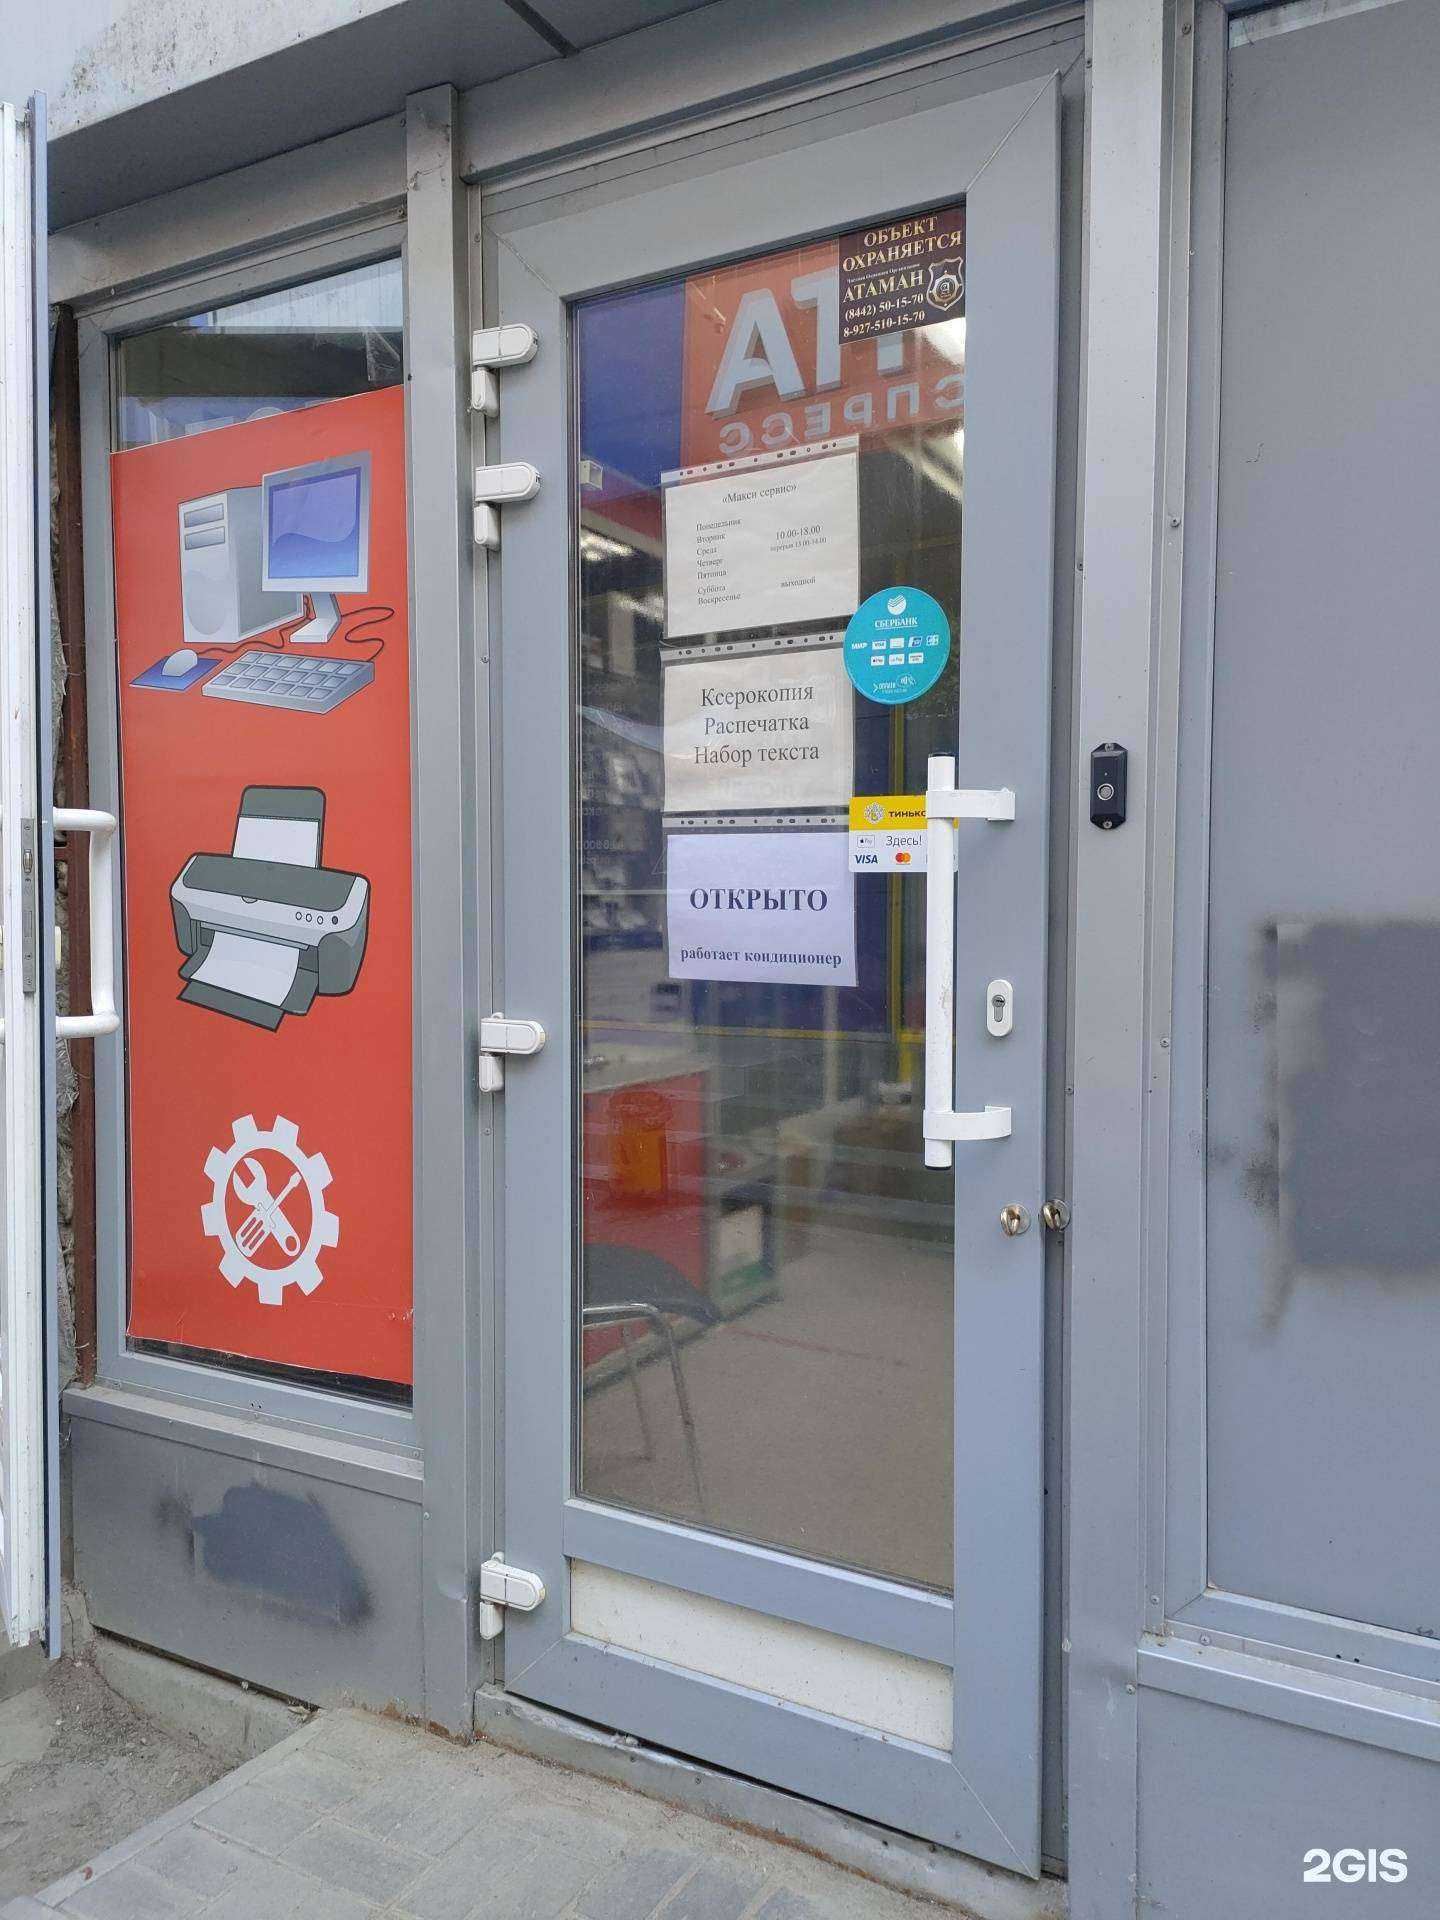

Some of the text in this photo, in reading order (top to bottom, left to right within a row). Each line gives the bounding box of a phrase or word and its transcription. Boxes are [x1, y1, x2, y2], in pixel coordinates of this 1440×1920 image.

[863, 216, 938, 248] ОБЪЕКТ
[842, 230, 963, 273] ОХРАНЯЕТСЯ
[842, 269, 924, 303] АТАМАН
[845, 293, 924, 322] (8442) 50-15-70
[843, 311, 926, 338] 8-927-510-15-70
[722, 484, 797, 504] «Макси сервис»
[874, 617, 918, 628] СБЕРБАНК
[700, 686, 814, 709] Ксерокопия
[704, 714, 809, 735] Распечатка
[695, 744, 820, 767] Набор текста
[888, 810, 926, 818] ТИНЬКО
[886, 835, 923, 848] Здесь!
[855, 854, 879, 864] VISA
[690, 888, 828, 911] ОТКРЫТО
[681, 947, 842, 968] работает кондиционер
